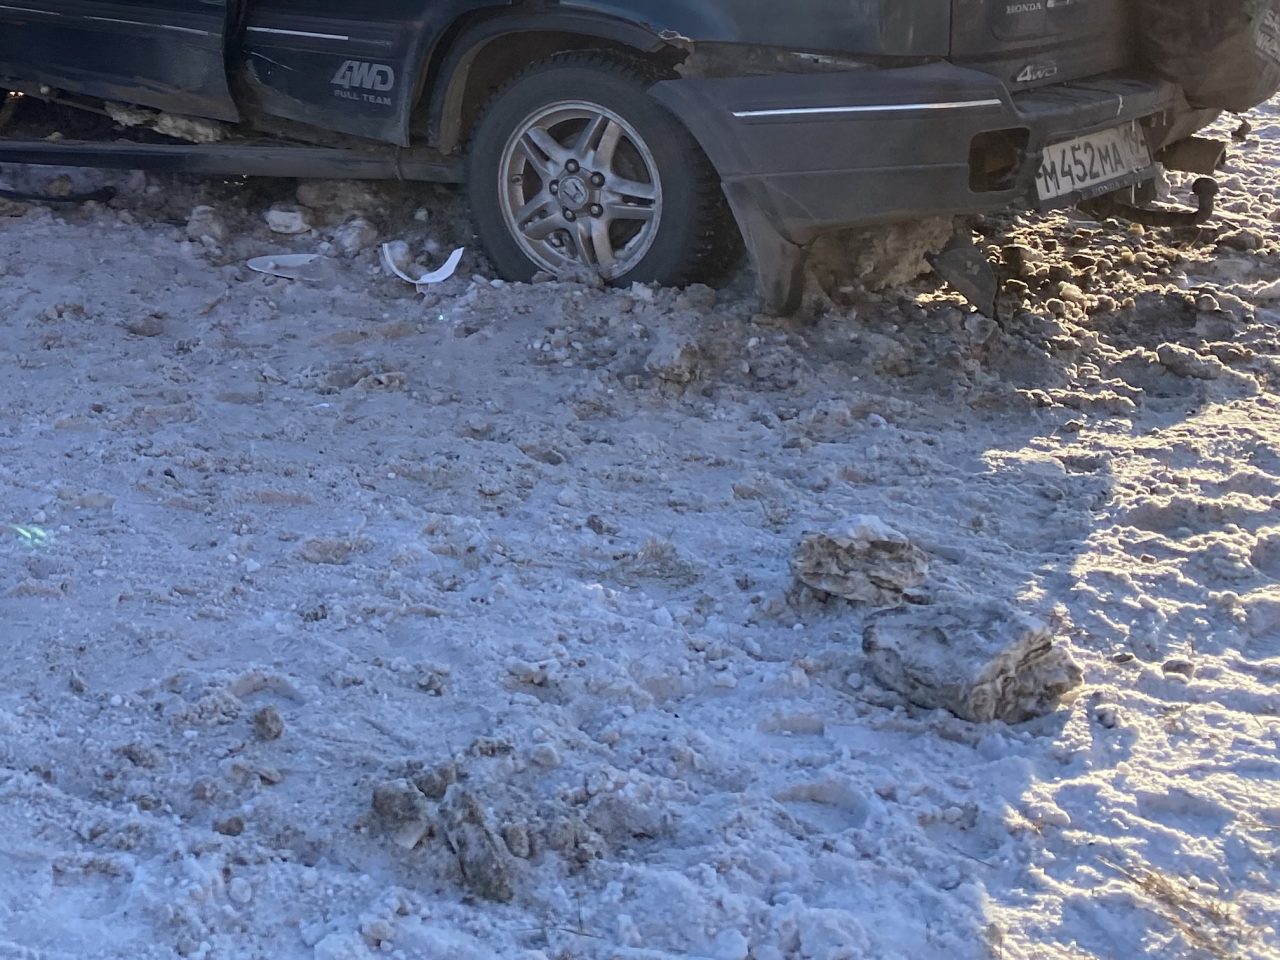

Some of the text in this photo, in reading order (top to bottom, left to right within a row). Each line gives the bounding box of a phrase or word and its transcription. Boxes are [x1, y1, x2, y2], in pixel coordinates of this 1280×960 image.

[1006, 2, 1042, 14] HONDA
[330, 59, 395, 91] 4WD
[1016, 65, 1057, 82] 4WD
[334, 90, 392, 106] FULL TEAM
[1041, 141, 1125, 194] М452МА
